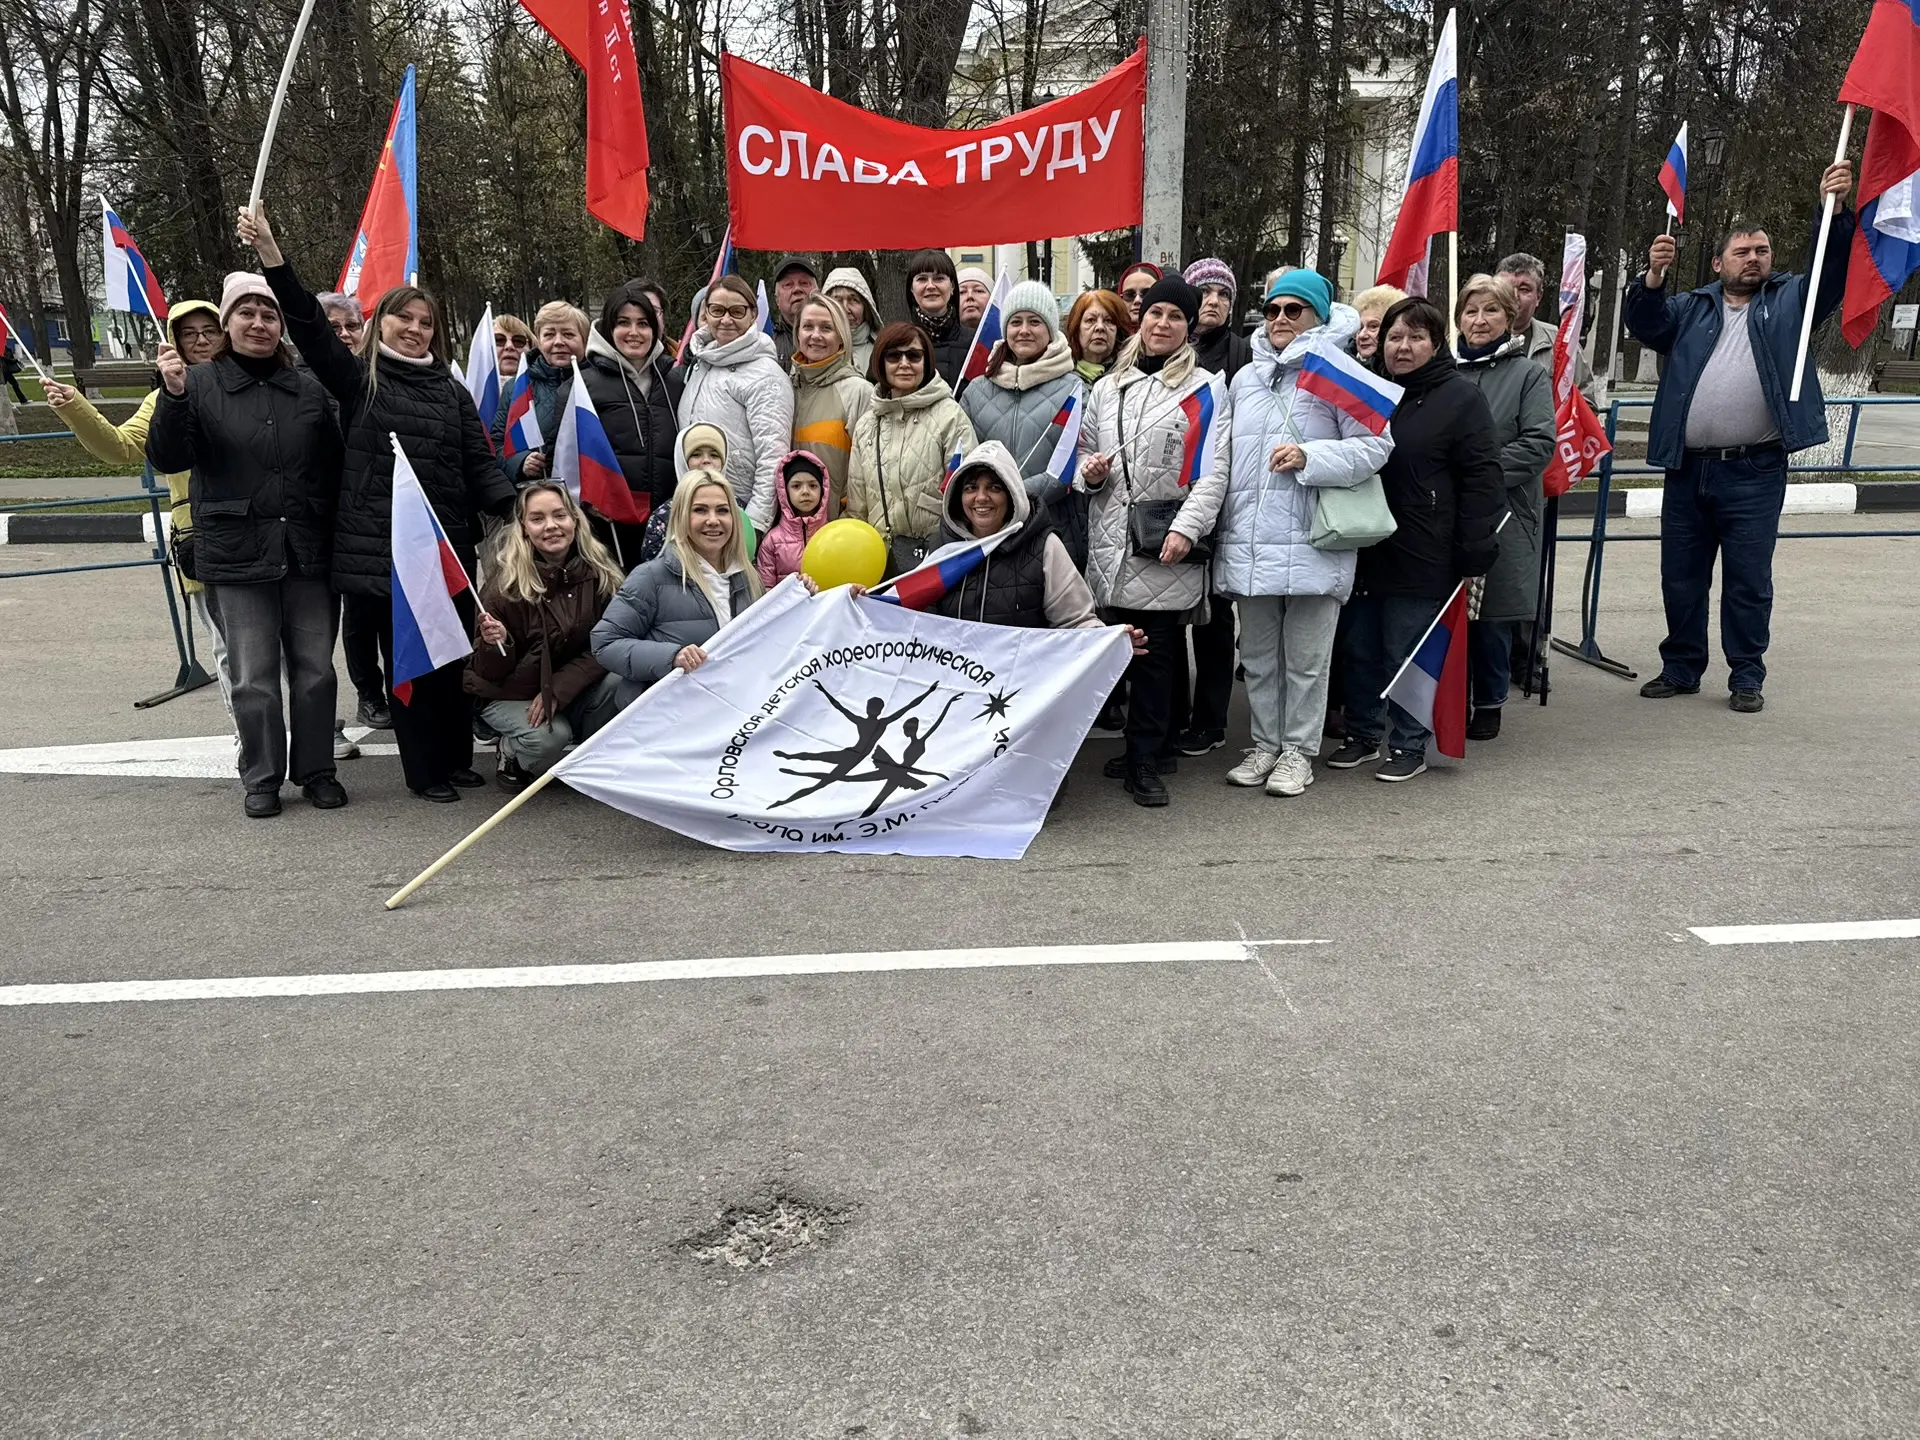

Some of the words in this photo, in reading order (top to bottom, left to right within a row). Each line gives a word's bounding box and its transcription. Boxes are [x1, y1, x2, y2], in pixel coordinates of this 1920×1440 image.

[738, 124, 928, 186] СЛАВА
[945, 109, 1122, 184] ТРУДУ
[710, 714, 763, 799] Орловская
[761, 657, 822, 715] детская
[825, 637, 996, 687] хореографическая
